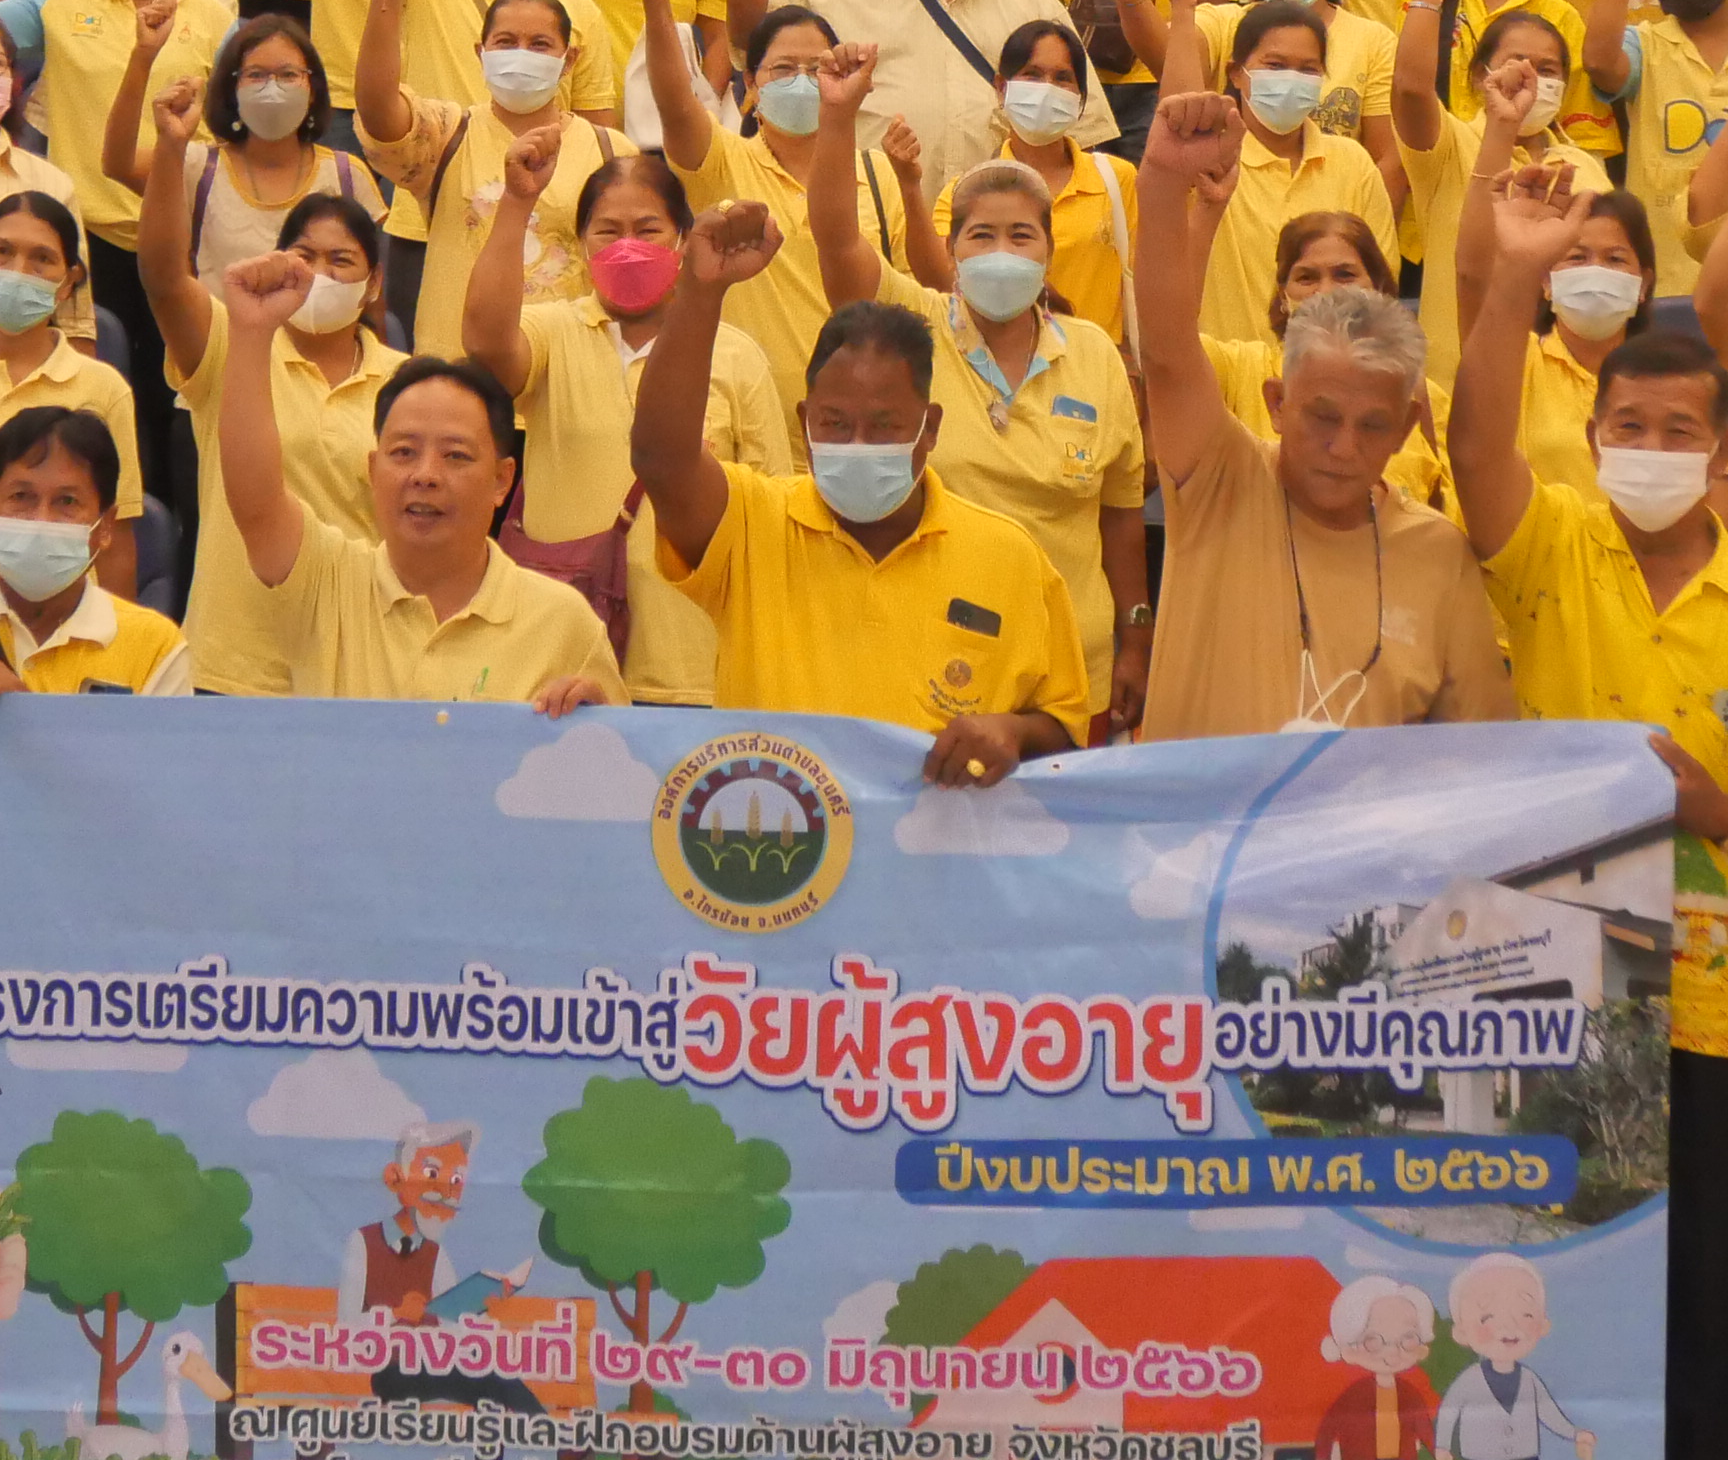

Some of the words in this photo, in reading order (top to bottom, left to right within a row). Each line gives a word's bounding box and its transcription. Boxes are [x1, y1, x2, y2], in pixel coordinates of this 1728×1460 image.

[936, 1146, 1250, 1196] ปีงบประมาณ
[1272, 1156, 1377, 1194] พ.ศ.
[1392, 1146, 1552, 1191] ๒๕๖๖
[256, 1305, 572, 1376] ระหว่างวันที่
[829, 1337, 1063, 1408] มิถุนายน
[1080, 1345, 1257, 1392] ๒๕๖๖
